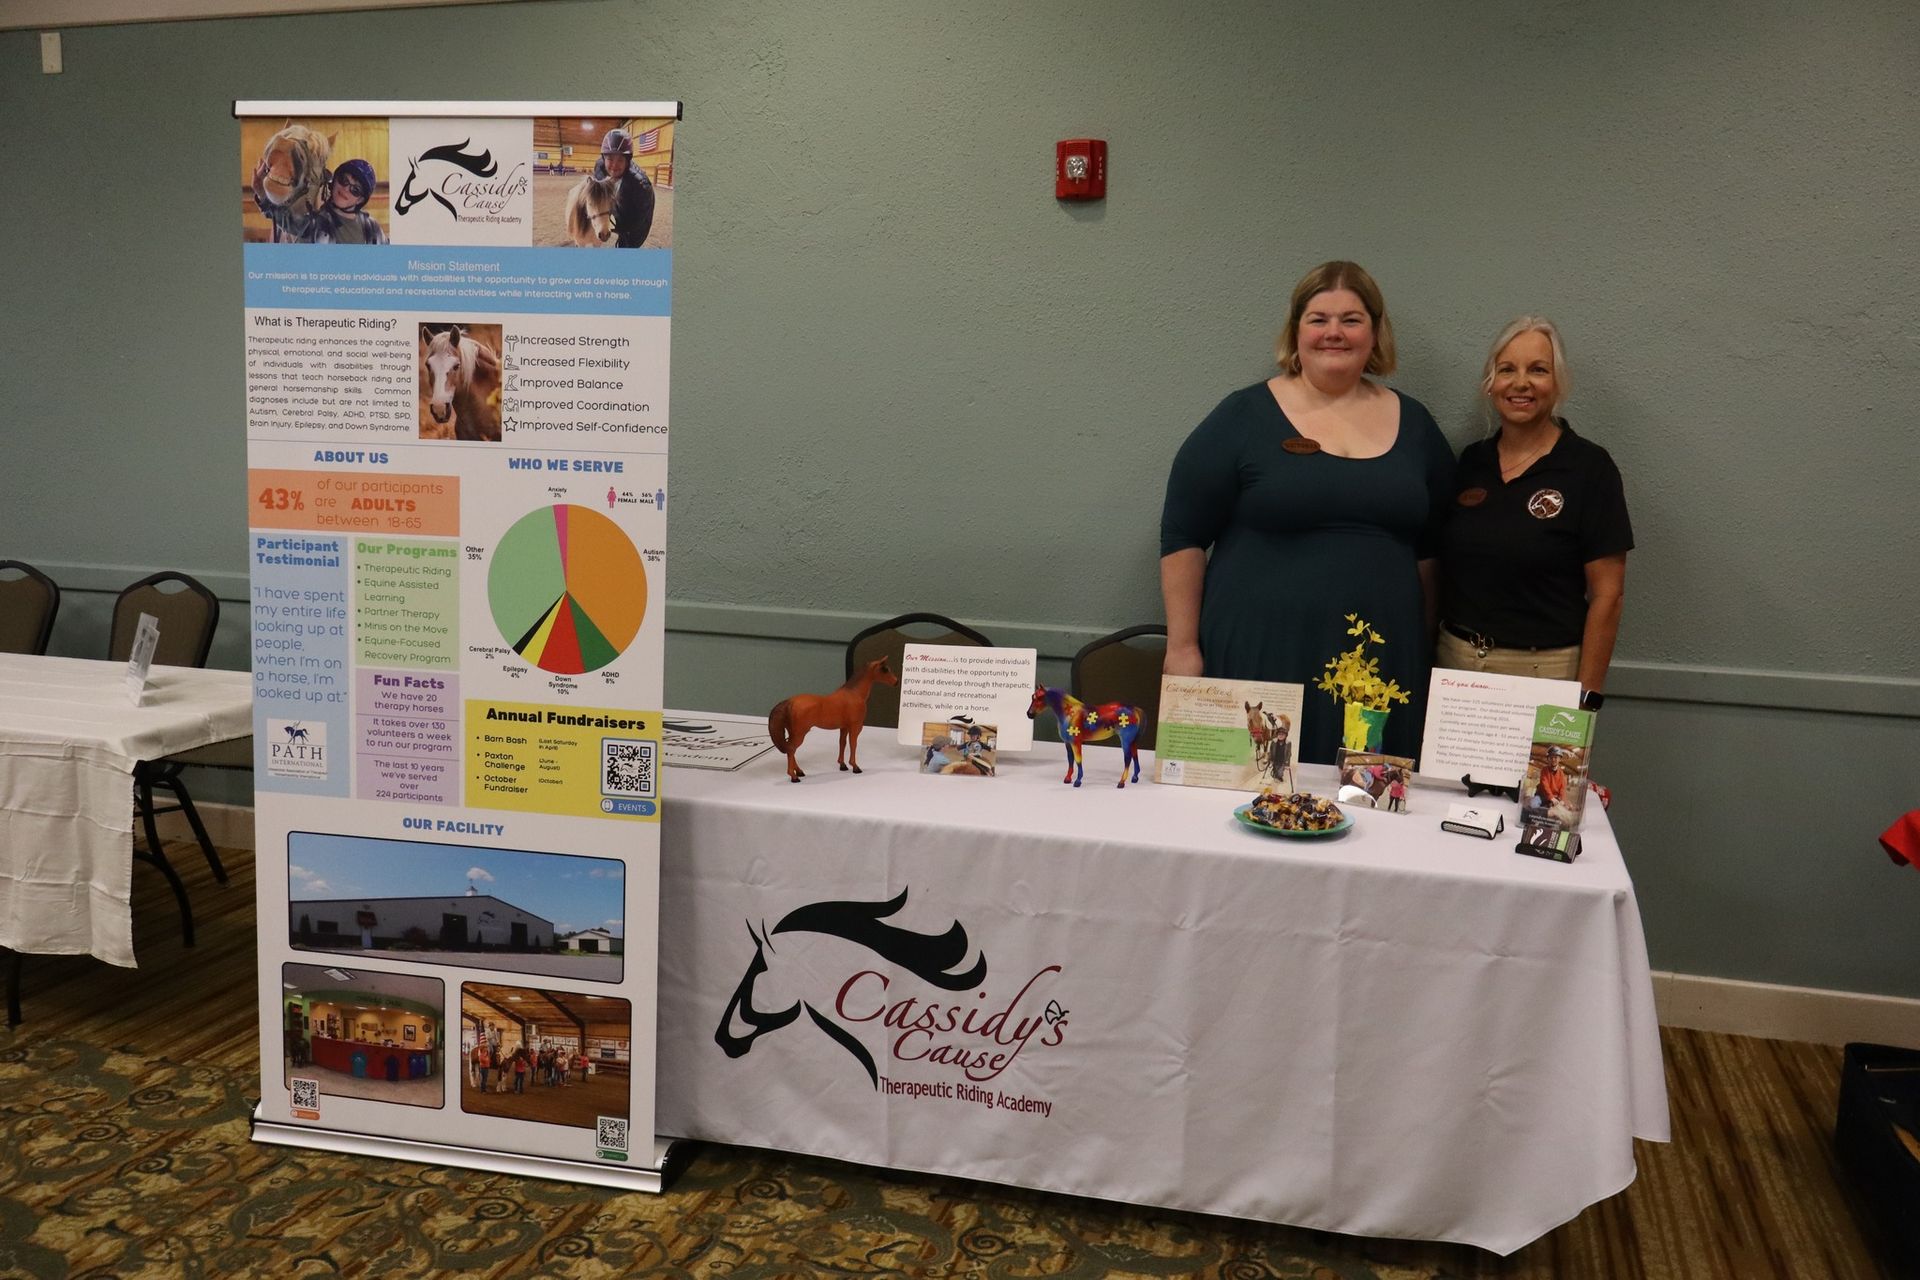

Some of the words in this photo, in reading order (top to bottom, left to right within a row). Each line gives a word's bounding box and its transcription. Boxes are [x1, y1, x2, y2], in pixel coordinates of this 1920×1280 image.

[442, 163, 526, 214] Cassidy's
[464, 194, 504, 209] Cause
[458, 215, 484, 223] Therapeutic
[486, 216, 500, 224] Riding
[501, 216, 521, 224] Academy
[408, 261, 446, 271] Mission
[448, 261, 500, 272] Statement
[255, 316, 281, 327] What
[284, 317, 292, 327] is
[296, 317, 356, 330] Therapeutic
[359, 318, 397, 331] Riding?
[520, 336, 576, 346] Increased
[578, 336, 630, 349] Strength
[520, 357, 576, 367] Increased
[578, 358, 630, 371] Flexibility
[520, 378, 574, 391] Improved
[578, 379, 623, 390] Balance
[520, 400, 574, 412] Improved
[577, 400, 650, 412] Coordination
[519, 420, 574, 432] Improved
[576, 422, 668, 434] Self-Confidence
[314, 451, 365, 463] ABOUT
[369, 453, 389, 464] US
[509, 458, 542, 470] WHO
[547, 460, 568, 471] WE
[573, 460, 624, 473] SERVE
[317, 479, 330, 490] of
[335, 481, 357, 491] our
[362, 482, 443, 496] participants
[259, 488, 305, 511] 43%
[315, 498, 336, 508] are
[351, 498, 416, 512] ADULTS
[317, 514, 379, 527] between
[388, 517, 421, 529] 18-65
[257, 538, 339, 553] Participant
[358, 543, 382, 554] Our
[387, 544, 457, 559] Programs
[256, 553, 340, 567] Testimonial
[364, 564, 420, 575] Therapeutic
[422, 567, 451, 578] Riding
[364, 578, 397, 588] Equine
[399, 580, 439, 590] Assisted
[265, 587, 300, 600] have
[304, 590, 344, 603] spent
[365, 593, 405, 605] Learning
[255, 605, 277, 618] my
[282, 606, 322, 618] entire
[327, 607, 346, 619] life
[365, 608, 399, 617] Partner
[401, 609, 440, 620] Therapy
[255, 620, 303, 636] looking
[308, 625, 325, 637] up
[330, 625, 344, 636] at
[365, 622, 387, 631] Minis
[424, 626, 448, 634] Move
[365, 636, 441, 648] Equine-Focused
[256, 654, 296, 666] when
[301, 656, 320, 667] I'm
[324, 660, 342, 669] on
[365, 651, 407, 662] Recovery
[410, 653, 451, 664] Program
[503, 666, 528, 674] Epilepsy
[921, 667, 956, 675] disabilities
[970, 669, 1009, 677] opportunity
[256, 672, 264, 681] a
[269, 671, 310, 685] horse,
[314, 674, 334, 685] I'm
[374, 675, 400, 687] Fun
[405, 677, 445, 689] Facts
[548, 682, 578, 690] Syndrome
[257, 687, 300, 700] looked
[306, 692, 323, 703] up
[382, 691, 398, 699] We
[401, 692, 424, 701] have
[426, 694, 437, 702] 20
[375, 702, 410, 712] therapy
[413, 704, 444, 713] horses
[373, 718, 379, 726] It
[382, 719, 407, 727] takes
[432, 722, 446, 730] 130
[486, 708, 542, 723] Annual
[547, 712, 646, 730] Fundraisers
[367, 729, 415, 739] volunteers
[485, 735, 504, 743] Barn
[506, 736, 527, 745] Bash
[272, 744, 322, 760] PATH
[366, 739, 375, 747] to
[413, 743, 452, 752] program
[485, 752, 514, 760] Paxton
[272, 759, 324, 768] INTERNATIONAL
[374, 760, 391, 768] The
[393, 762, 409, 770] last
[421, 764, 444, 772] years
[485, 761, 526, 772] Challenge
[381, 771, 406, 780] we've
[408, 773, 438, 782] served
[484, 775, 517, 783] October
[484, 784, 528, 793] Fundraiser
[376, 790, 391, 798] 224
[393, 791, 443, 802] participants
[618, 803, 647, 812] EVENTS
[403, 817, 432, 830] OUR
[437, 820, 505, 836] FACILITY
[835, 965, 1069, 1081] Cassidy's
[893, 1028, 1005, 1071] Cause
[880, 1076, 953, 1099] Therapeutic
[956, 1083, 994, 1109] Riding
[997, 1090, 1052, 1117] Academy
